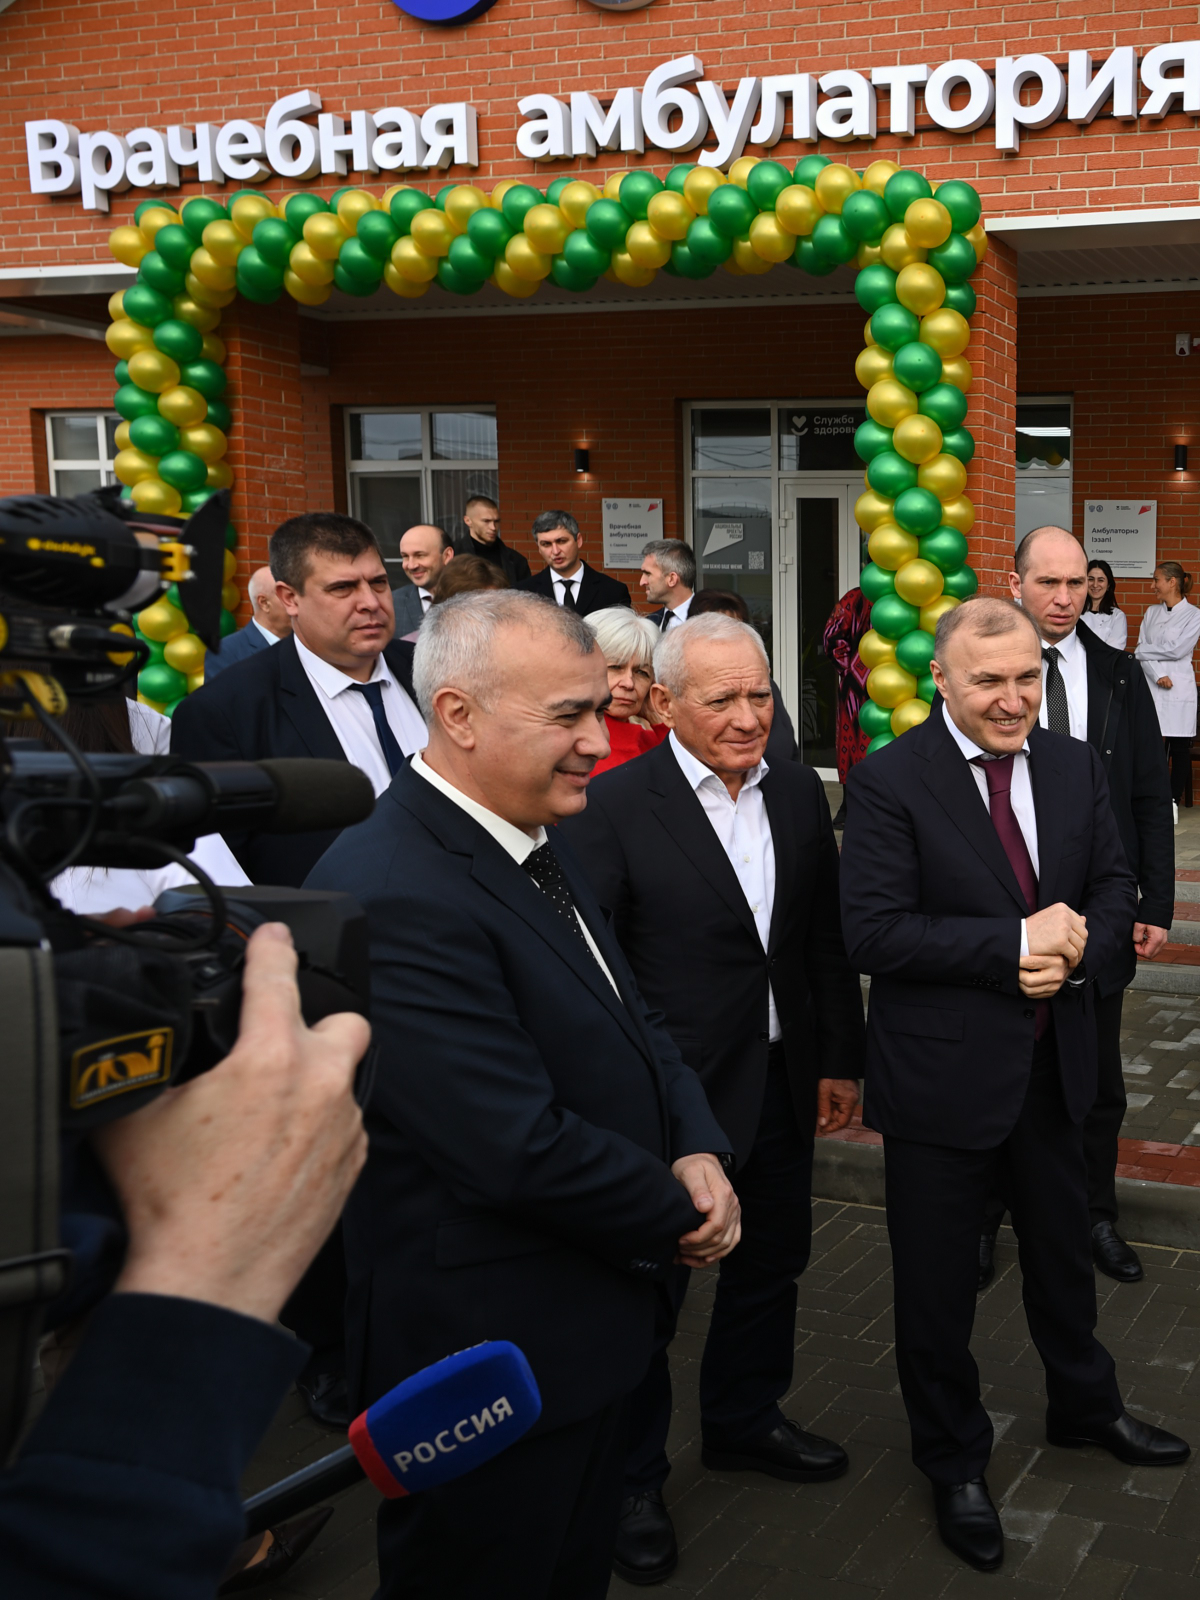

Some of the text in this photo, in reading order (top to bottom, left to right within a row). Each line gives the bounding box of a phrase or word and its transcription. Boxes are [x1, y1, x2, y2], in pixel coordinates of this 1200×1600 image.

[25, 89, 478, 212] Врачебная
[813, 415, 854, 426] Служба
[813, 426, 857, 436] здоровь
[1091, 527, 1139, 535] Амбулаторнэ
[392, 1396, 514, 1474] РОССИЯ
